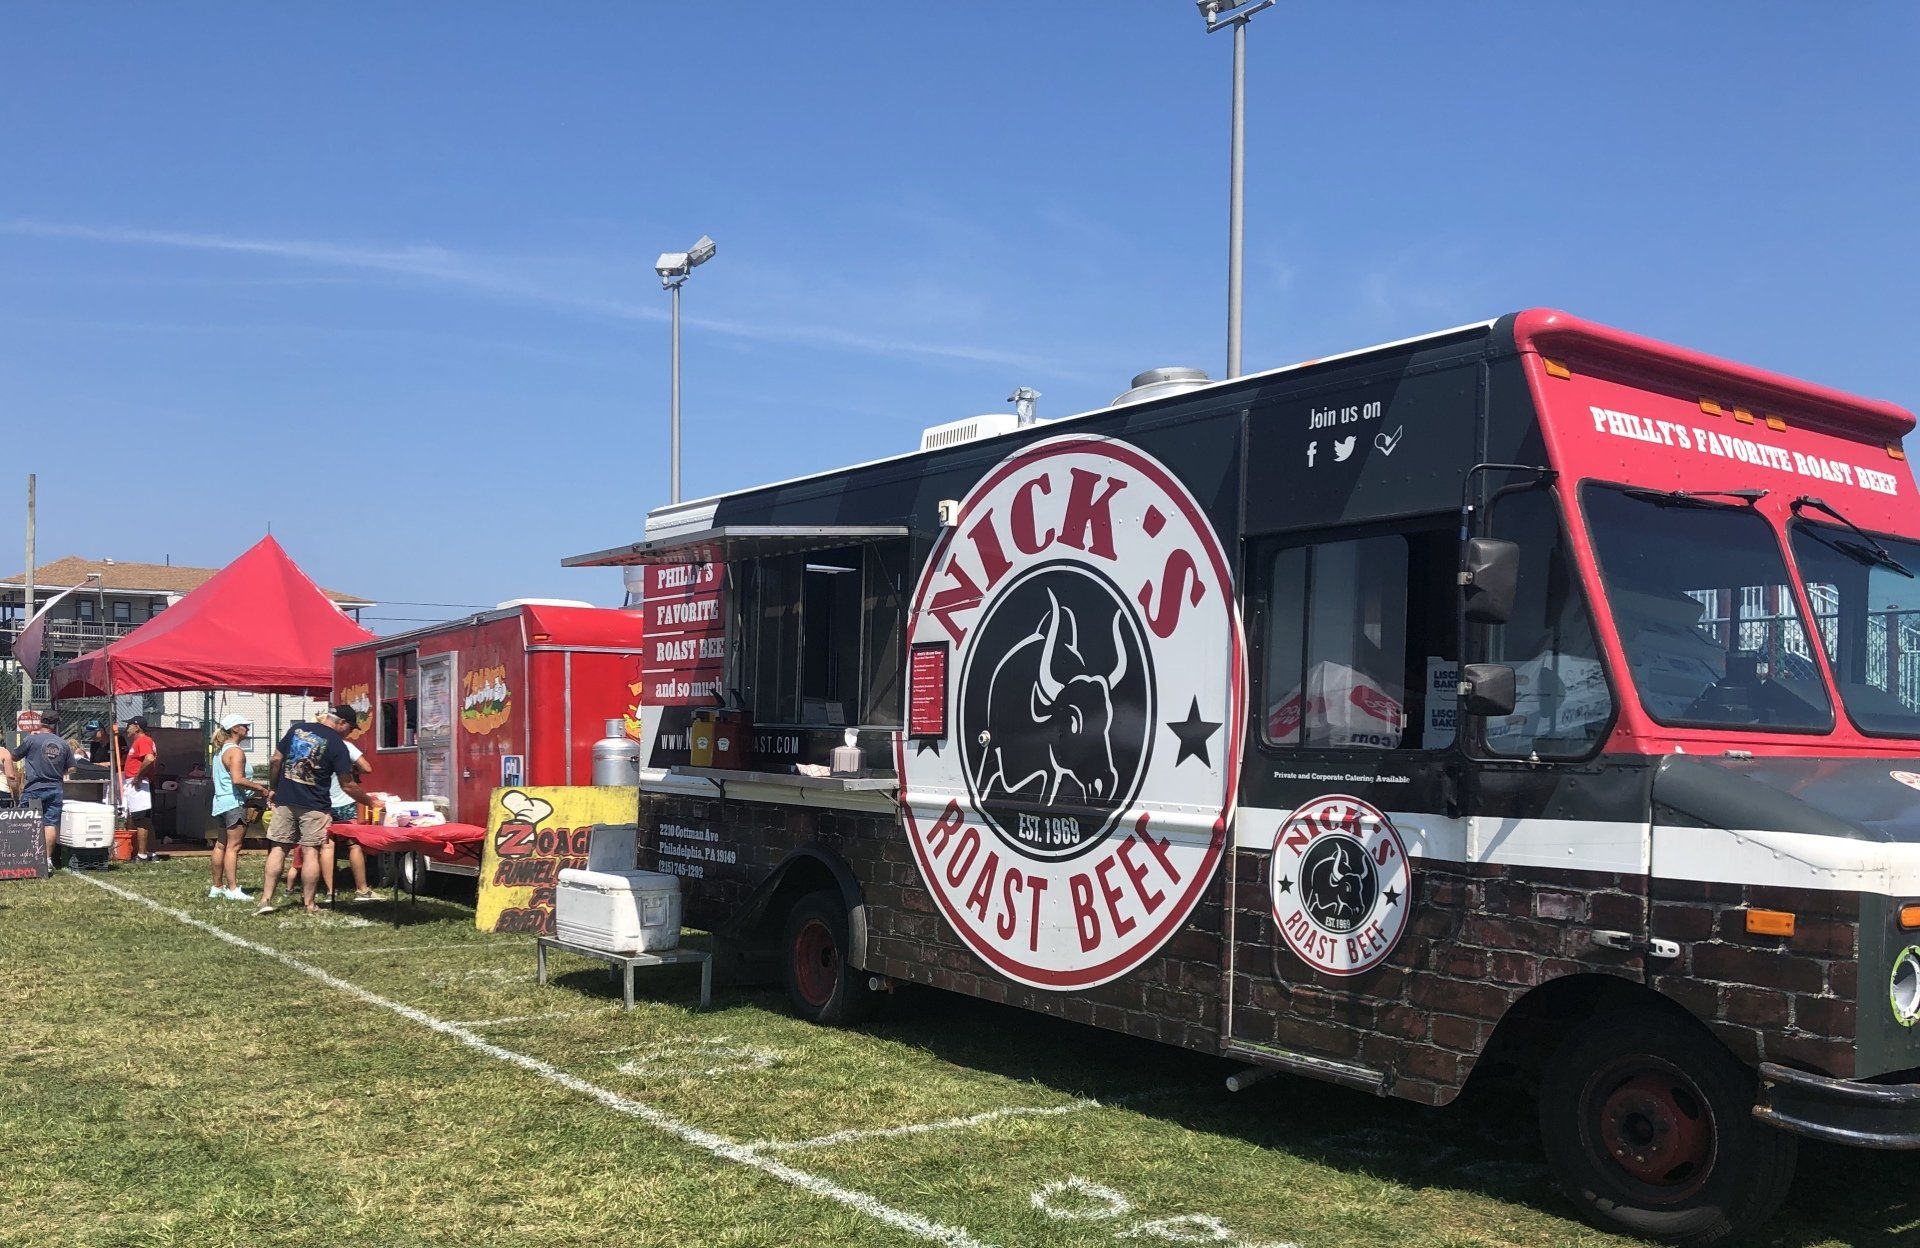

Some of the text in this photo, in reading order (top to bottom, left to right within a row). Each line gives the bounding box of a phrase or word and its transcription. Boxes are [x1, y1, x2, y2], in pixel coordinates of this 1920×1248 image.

[1308, 401, 1381, 429] Join us on
[1589, 405, 1898, 496] PHILLY'S FAVORITE ROAST BEEF
[927, 467, 1206, 651] NICK'S
[657, 563, 714, 589] PHILLY'S
[657, 599, 719, 626] FAVORITE
[656, 639, 697, 662] ROAST
[655, 676, 723, 698] and so much
[1274, 771, 1411, 784] Private and Corporate Catering Available
[659, 823, 719, 842] 2210 Cottman Ave
[1018, 812, 1080, 845] EST. 1969
[1284, 806, 1396, 866] NICK'S
[659, 841, 736, 865] Philadelphia, PA 19149
[658, 859, 674, 875] (215)
[927, 799, 1182, 956] ROAST BEEF
[1325, 916, 1351, 929] EST. 1969
[1285, 909, 1388, 964] ROAST BEEF
